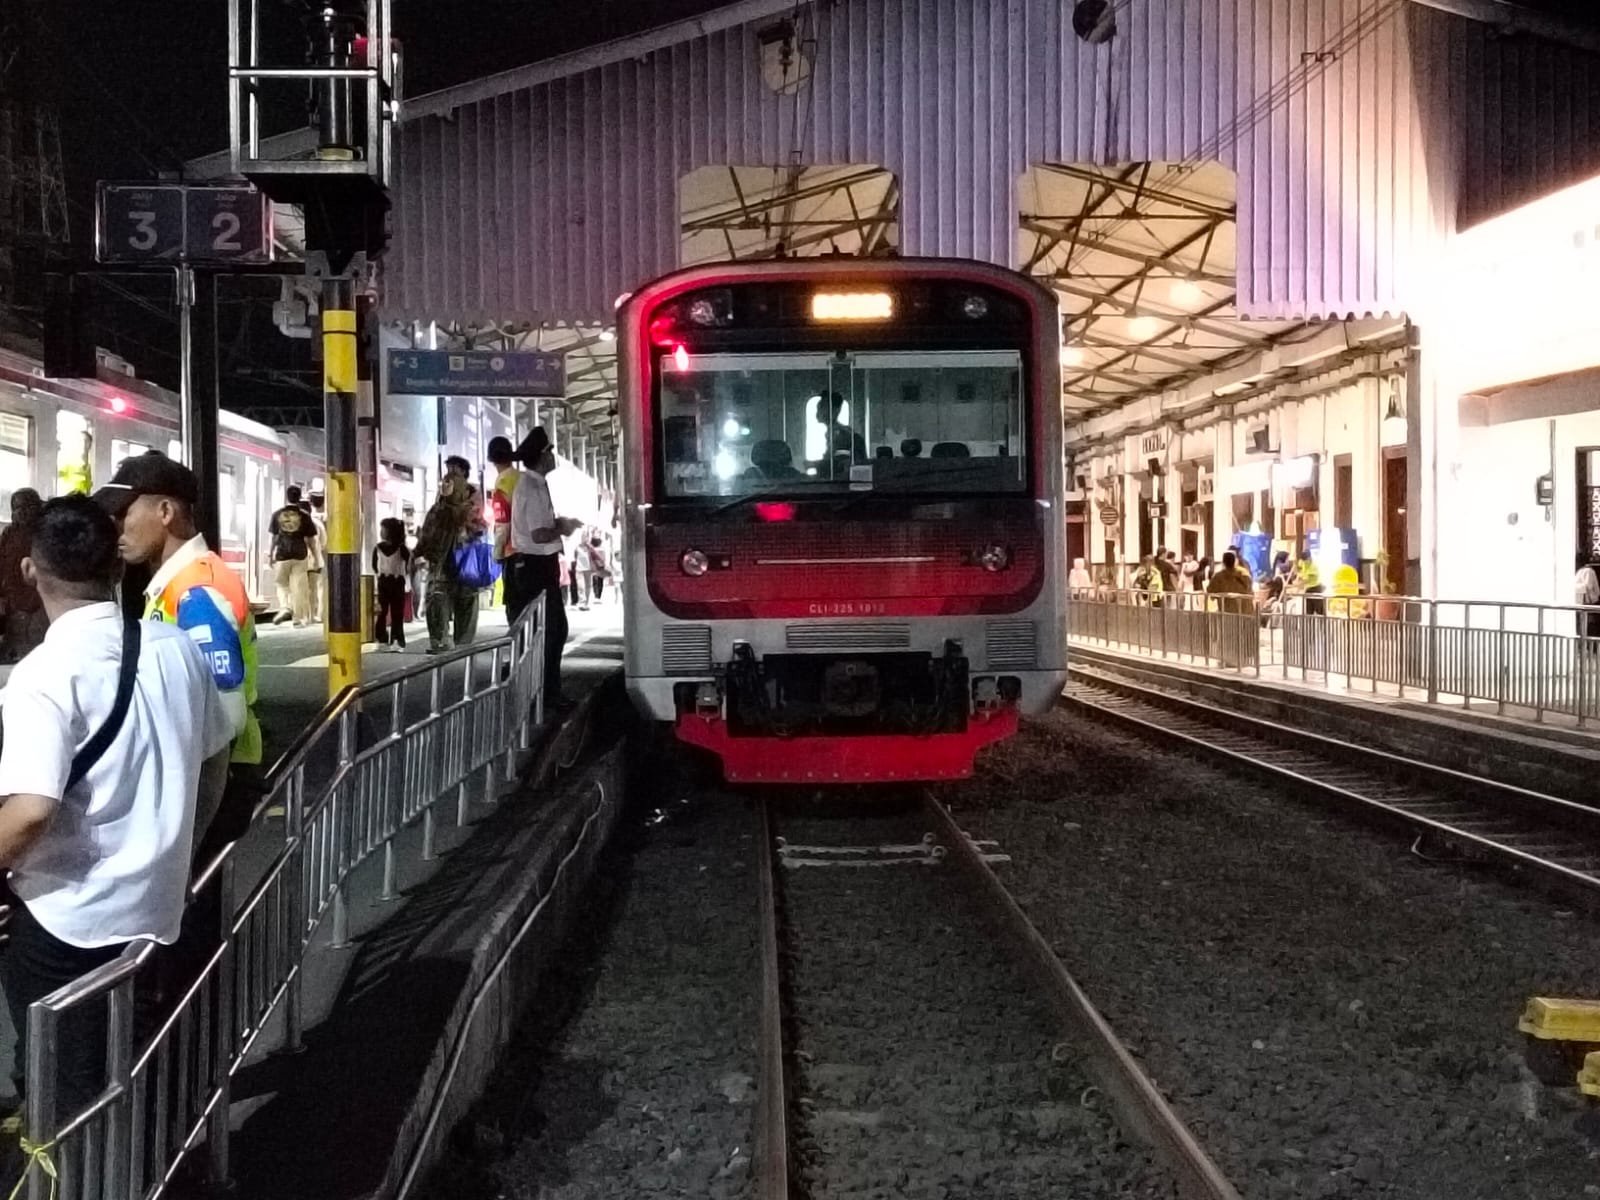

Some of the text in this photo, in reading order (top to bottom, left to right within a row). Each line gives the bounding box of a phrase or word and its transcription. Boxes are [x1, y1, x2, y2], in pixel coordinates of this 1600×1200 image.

[128, 211, 157, 250] 3
[212, 212, 241, 250] 2
[409, 357, 418, 369] 3
[535, 358, 545, 370] 2
[204, 650, 231, 674] NER
